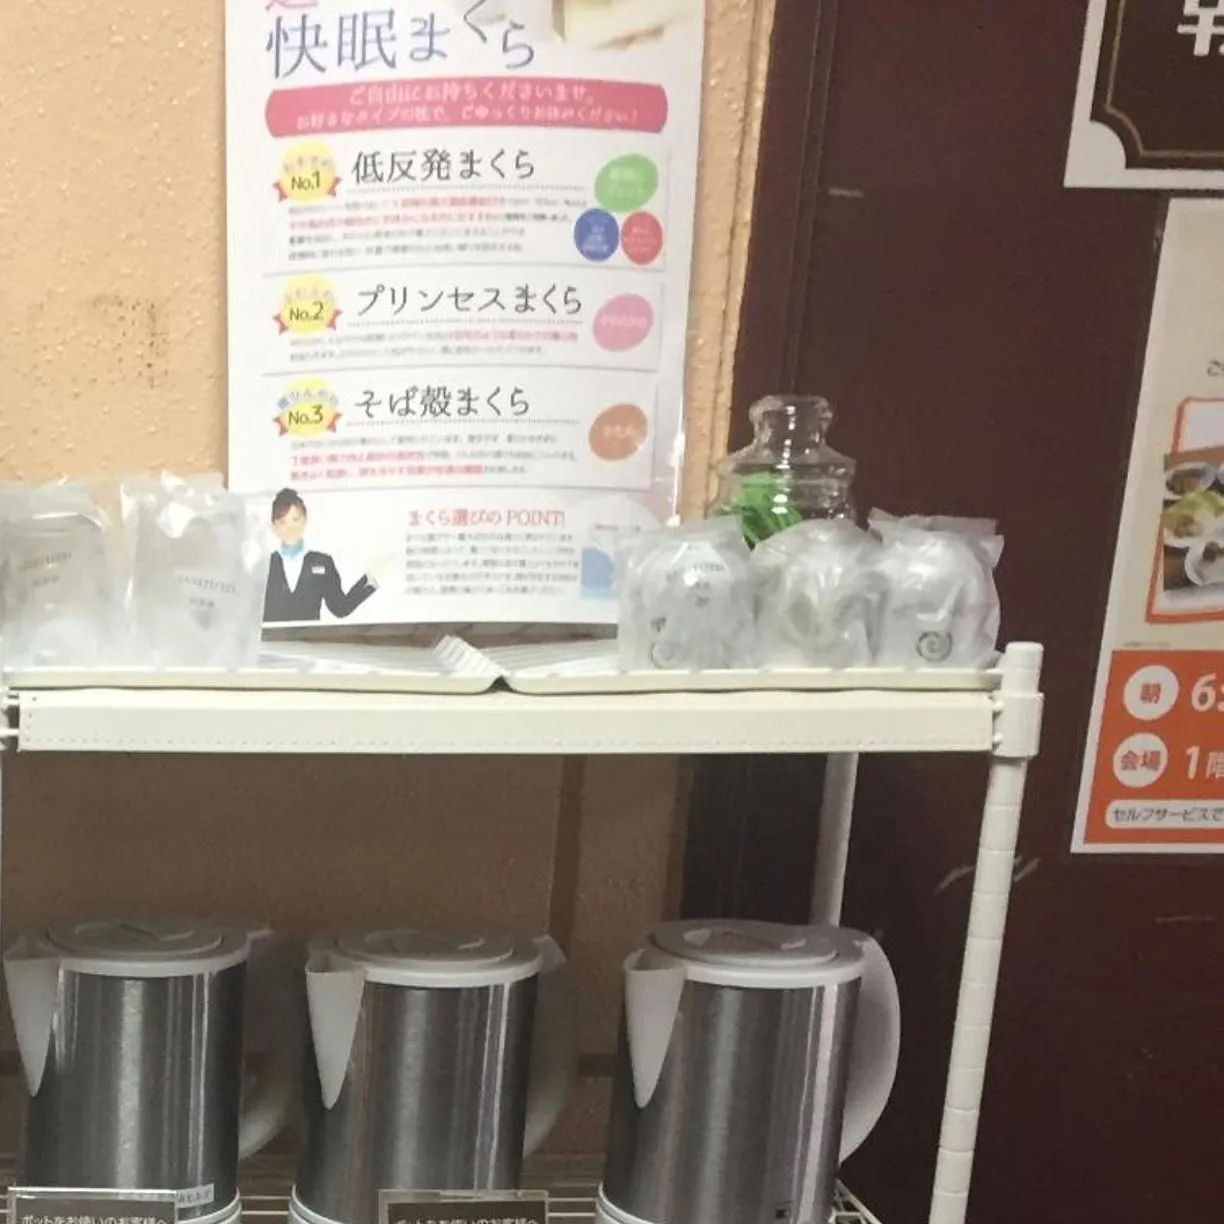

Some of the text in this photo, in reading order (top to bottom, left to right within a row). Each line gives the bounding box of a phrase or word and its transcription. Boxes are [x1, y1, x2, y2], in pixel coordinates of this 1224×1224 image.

[266, 3, 535, 79] 快眠まくら
[291, 169, 322, 191] No.1
[352, 149, 535, 184] 低反発まくら
[289, 301, 324, 321] No.2
[358, 283, 581, 316] プリンセスまくら
[288, 405, 323, 425] No.3
